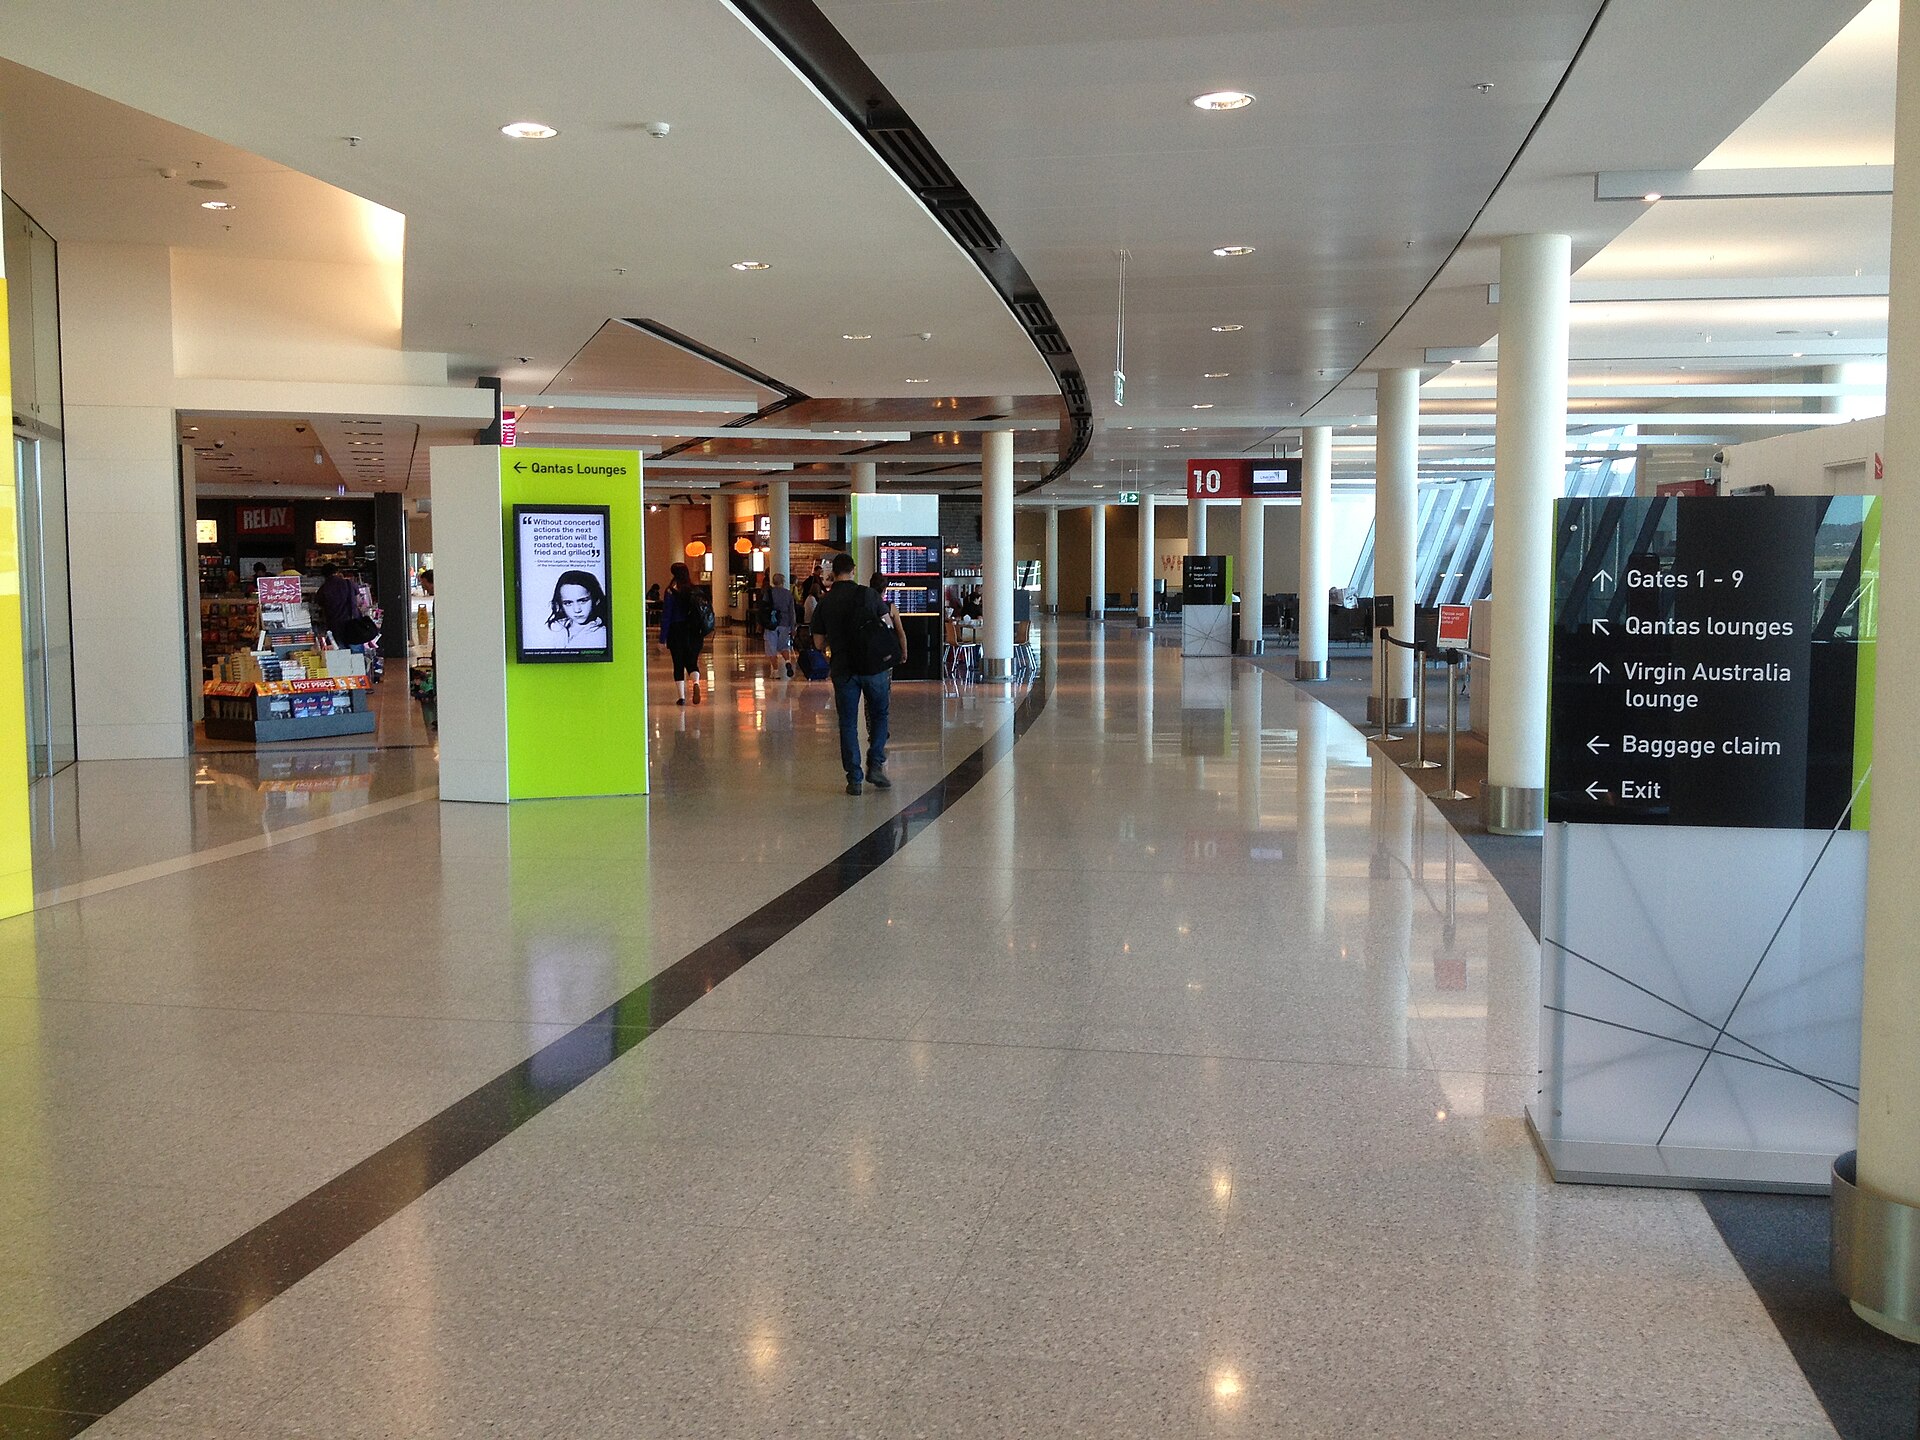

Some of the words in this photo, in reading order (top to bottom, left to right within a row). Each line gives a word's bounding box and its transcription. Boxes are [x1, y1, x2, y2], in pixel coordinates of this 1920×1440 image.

[531, 462, 574, 475] Qantas
[577, 463, 627, 477] Lounges
[1193, 469, 1221, 493] 10
[243, 507, 287, 530] RELAY
[1627, 569, 1688, 588] Gates
[1696, 569, 1704, 588] 1
[1732, 570, 1744, 588] 9
[1626, 616, 1700, 635] Qantas
[1707, 616, 1793, 640] lounges
[293, 681, 310, 690] HOT
[311, 678, 335, 689] PRICE
[1623, 662, 1686, 685] Virgin
[1692, 662, 1791, 682] Australia
[1625, 689, 1698, 712] lounge
[1622, 735, 1716, 758] Baggage
[1722, 736, 1781, 755] claim
[1621, 780, 1661, 799] Exit
